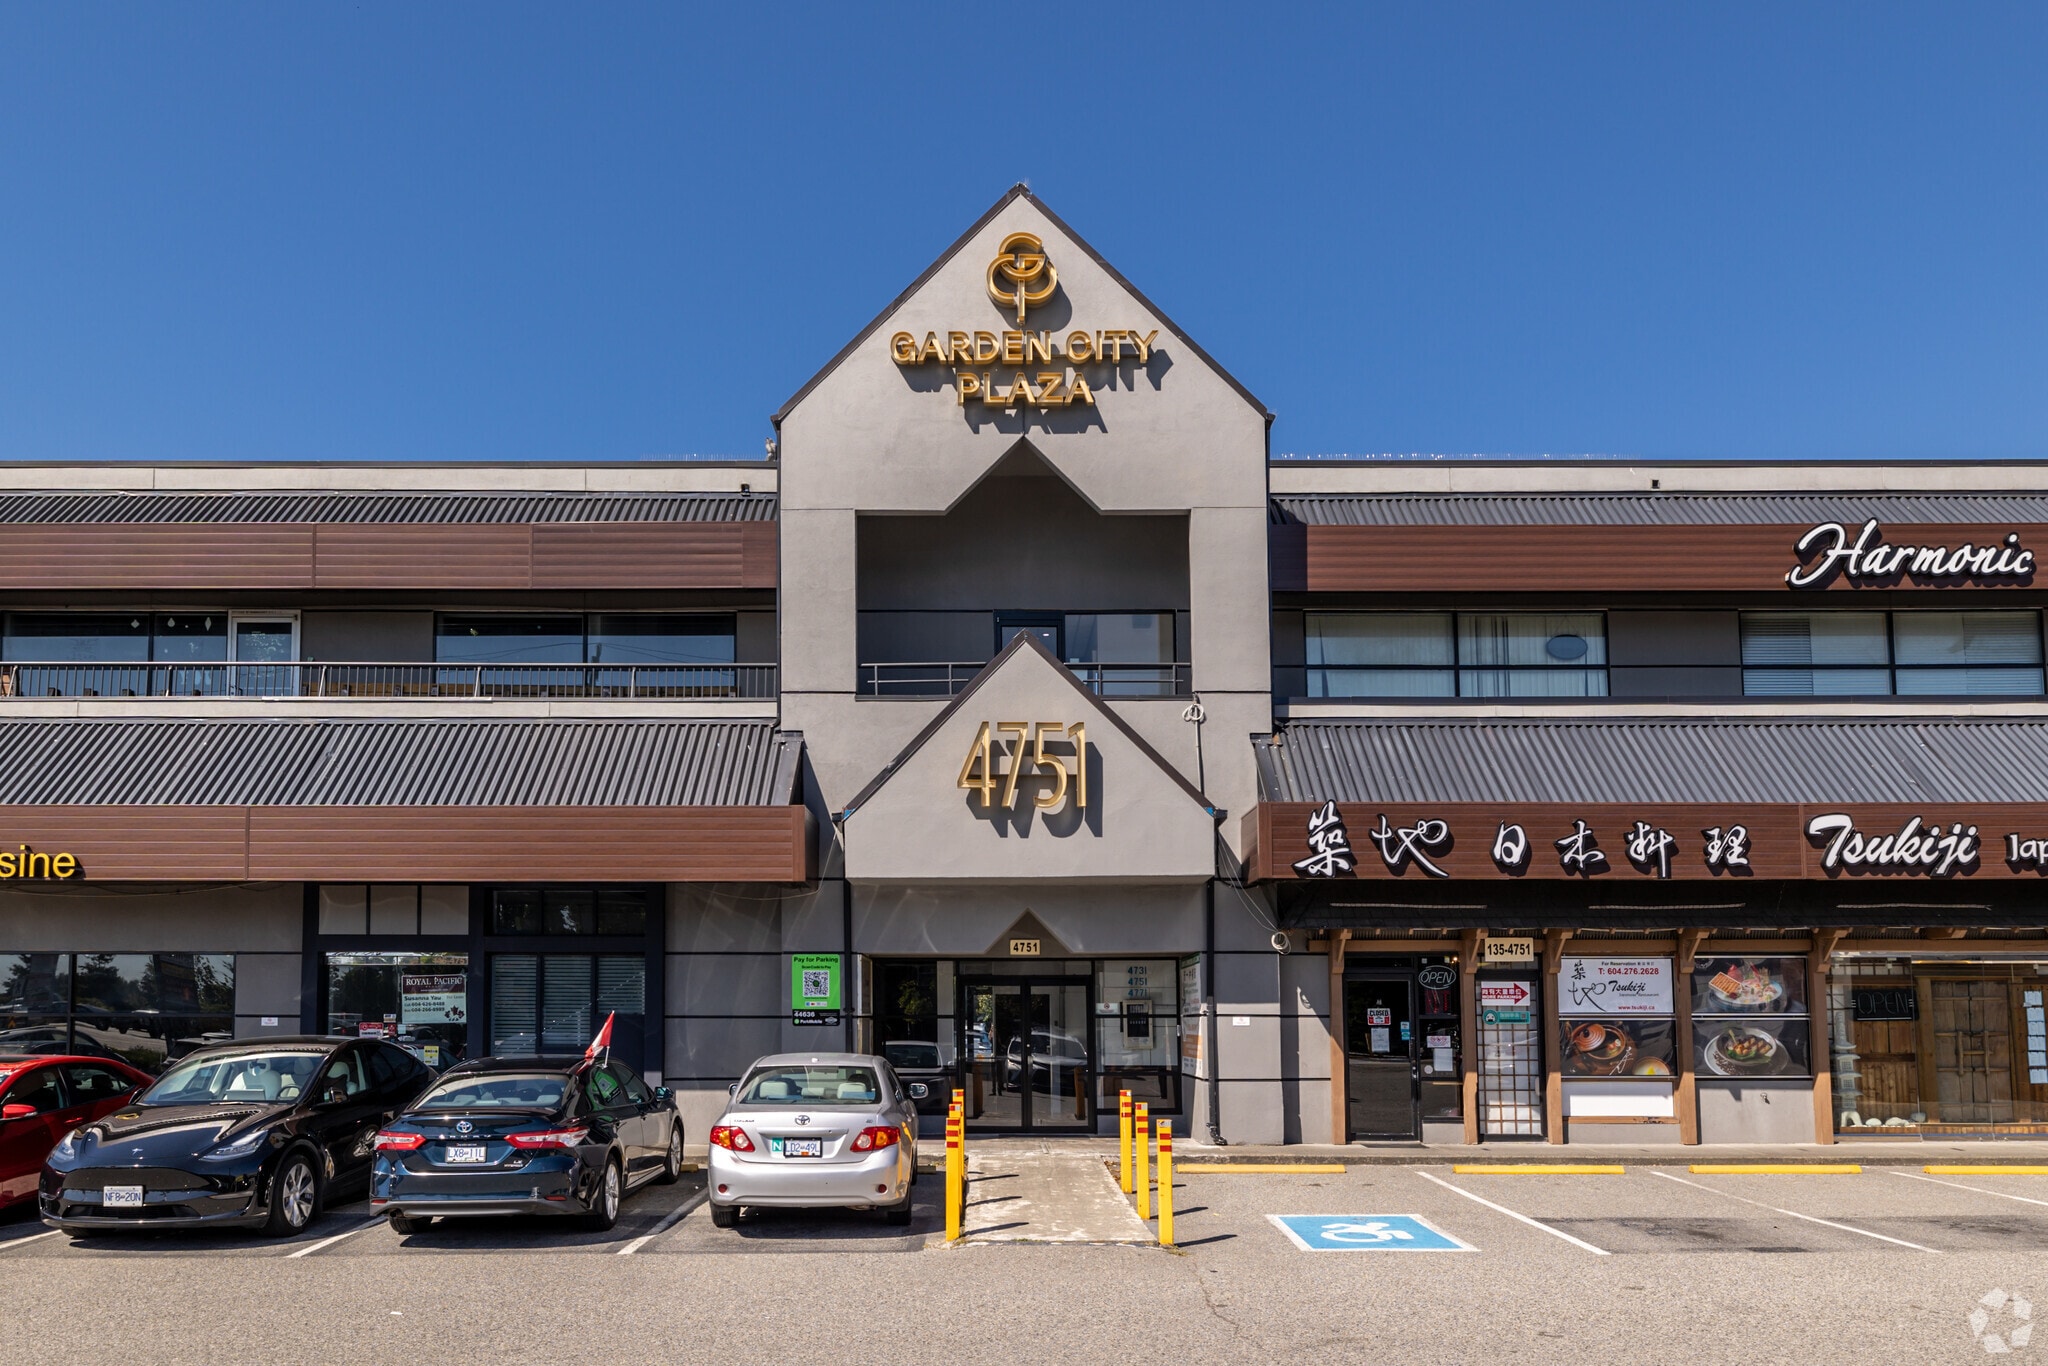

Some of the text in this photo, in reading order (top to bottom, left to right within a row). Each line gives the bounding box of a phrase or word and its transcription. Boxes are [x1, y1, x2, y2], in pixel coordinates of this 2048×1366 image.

[890, 330, 1159, 365] GARDEN CITY
[956, 372, 1095, 406] PLAZA
[1786, 518, 2035, 587] Harmonic
[957, 721, 1087, 808] 4751
[1807, 813, 1979, 876] Tsukiji
[0, 844, 76, 878] sine
[1013, 942, 1038, 953] 4751
[1487, 943, 1531, 956] 135-4751
[1420, 971, 1453, 984] OPEN
[1607, 967, 1660, 975] 604.276.2628
[406, 976, 463, 986] ROYAL PACIFIC
[1608, 980, 1647, 994] Tsukiji
[1858, 992, 1909, 1015] OPEN
[773, 1141, 783, 1151] N
